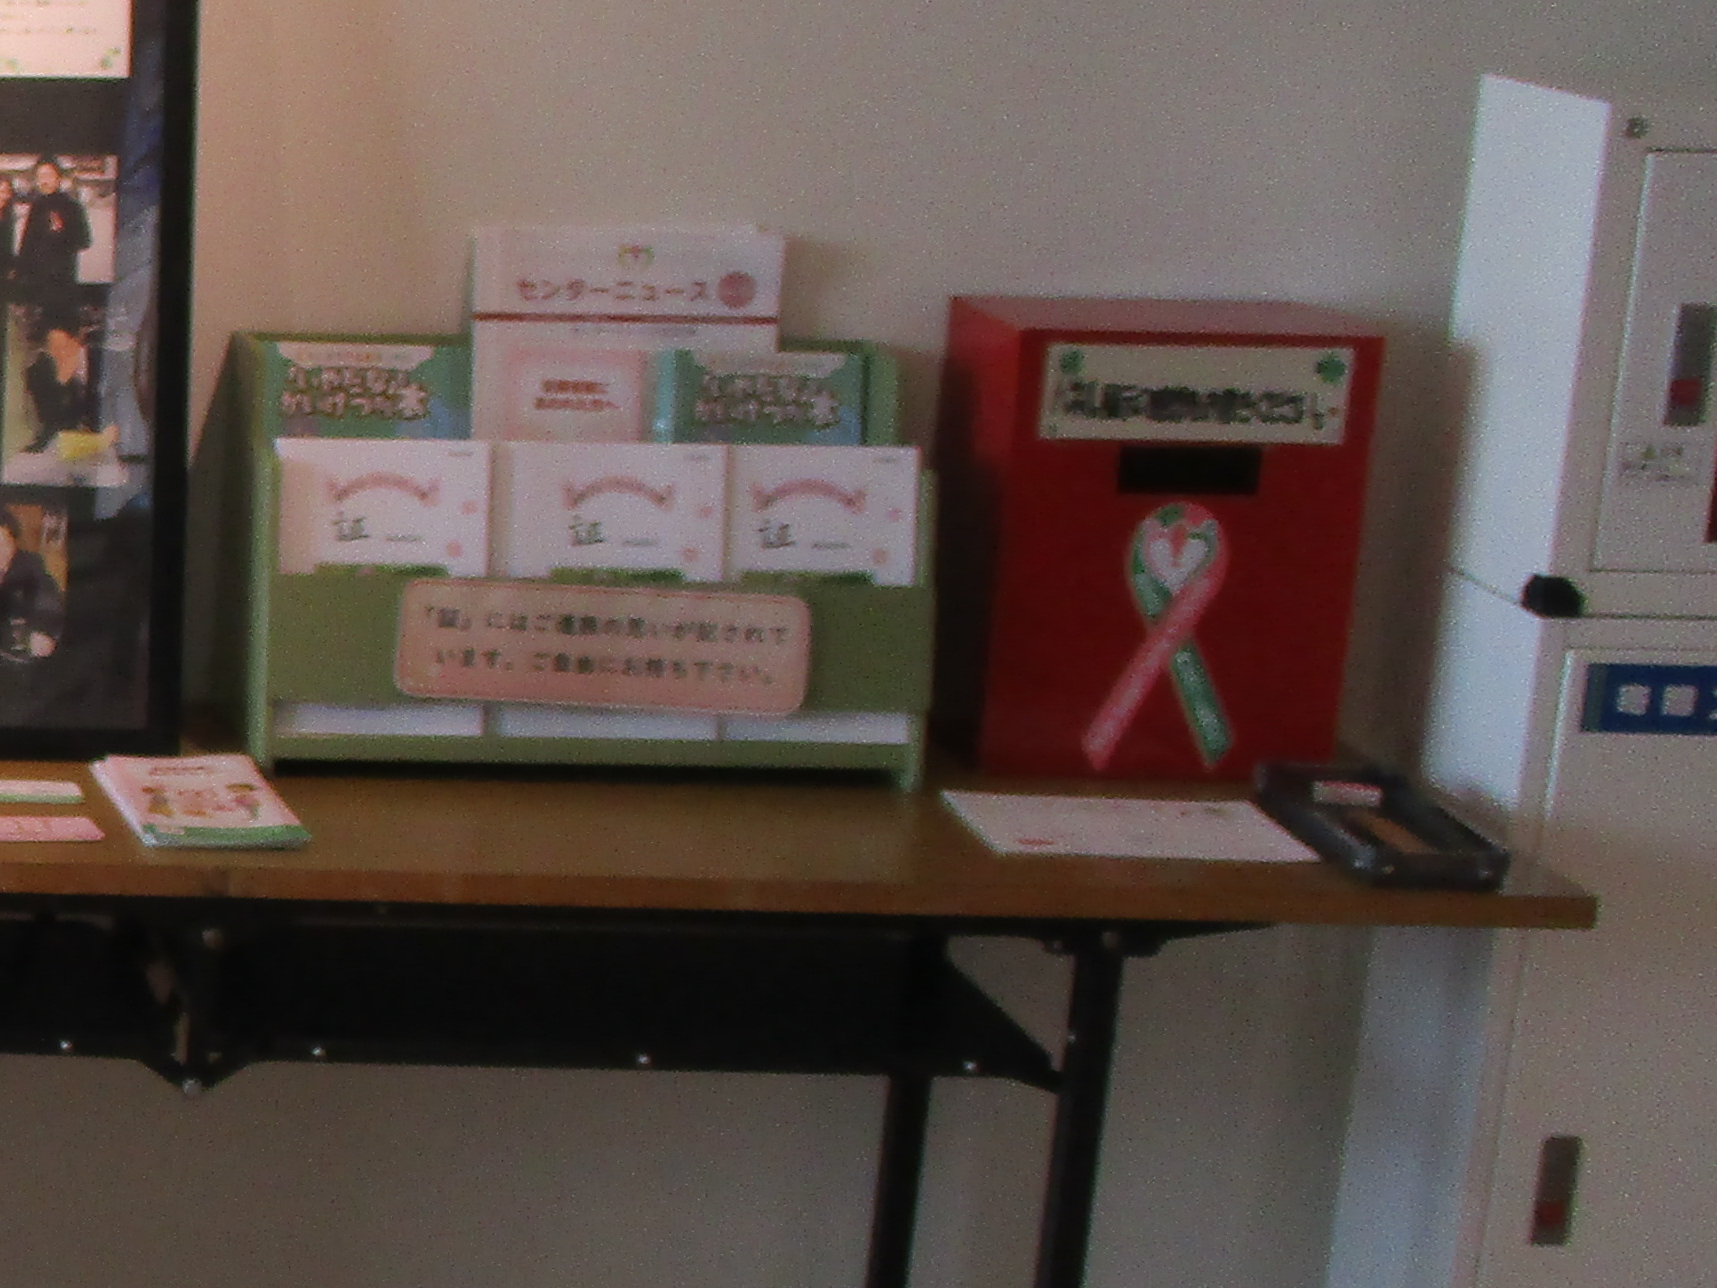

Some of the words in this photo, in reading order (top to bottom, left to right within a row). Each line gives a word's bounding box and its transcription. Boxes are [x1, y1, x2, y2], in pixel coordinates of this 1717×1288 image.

[517, 278, 709, 302] センターニュース
